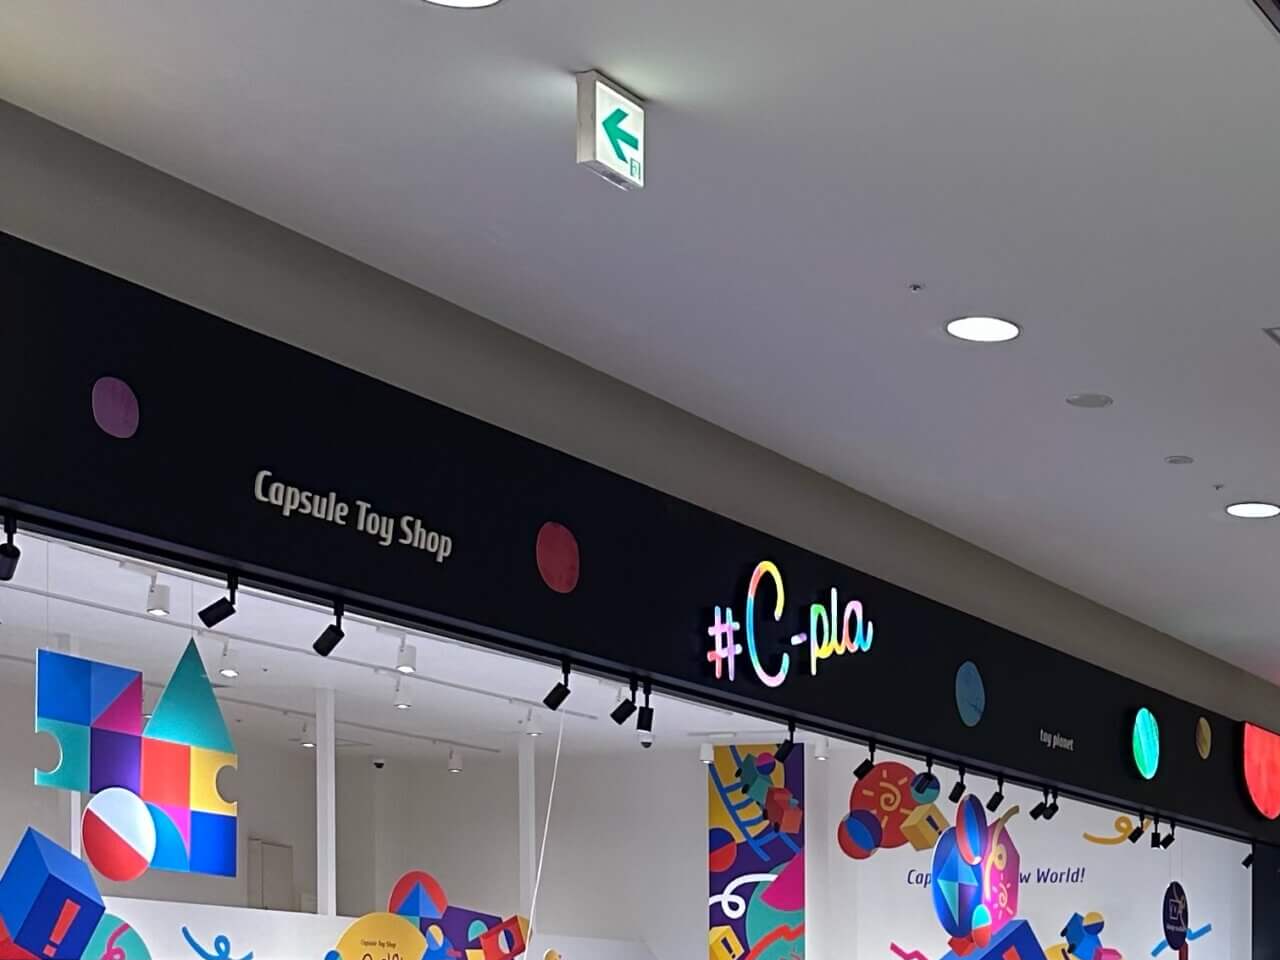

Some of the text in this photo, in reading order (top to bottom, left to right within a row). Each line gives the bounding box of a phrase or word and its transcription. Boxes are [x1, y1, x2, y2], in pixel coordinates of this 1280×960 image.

[254, 470, 452, 563] Capsule Toy Shop
[706, 560, 874, 688] #C-pla
[1036, 868, 1085, 884] World!
